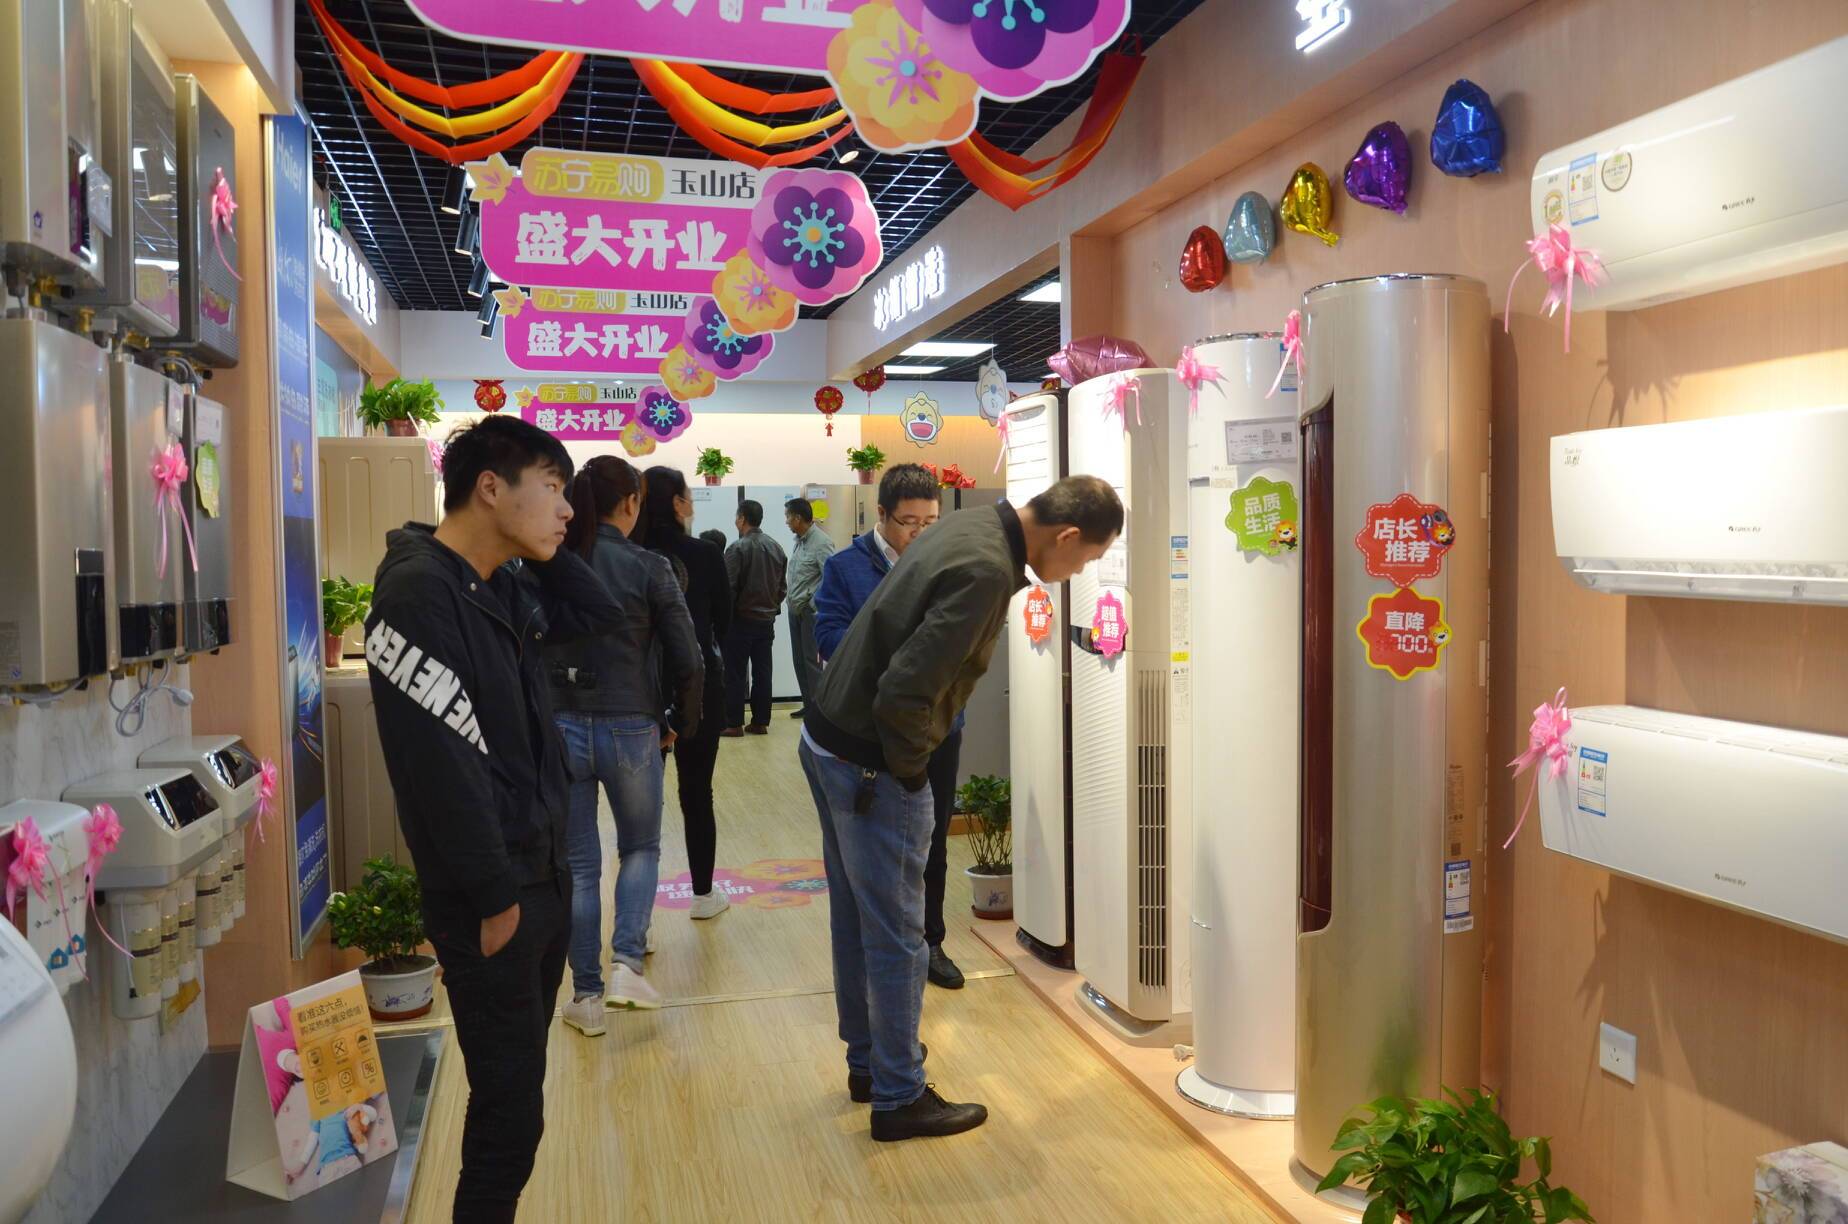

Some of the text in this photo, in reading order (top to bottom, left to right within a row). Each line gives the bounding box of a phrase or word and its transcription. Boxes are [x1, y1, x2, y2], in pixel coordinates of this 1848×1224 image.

[533, 157, 755, 199] 苏宁易购 玉山店
[515, 211, 727, 271] 盛大开业
[527, 320, 668, 359] 盛大开业
[536, 409, 625, 431] 盛大开业
[1245, 493, 1281, 515] 品质
[1245, 511, 1280, 535] 生活
[1373, 517, 1418, 539] 店长
[1385, 540, 1430, 562] 推荐
[1384, 611, 1424, 631] 直降
[366, 619, 461, 718] NEVER
